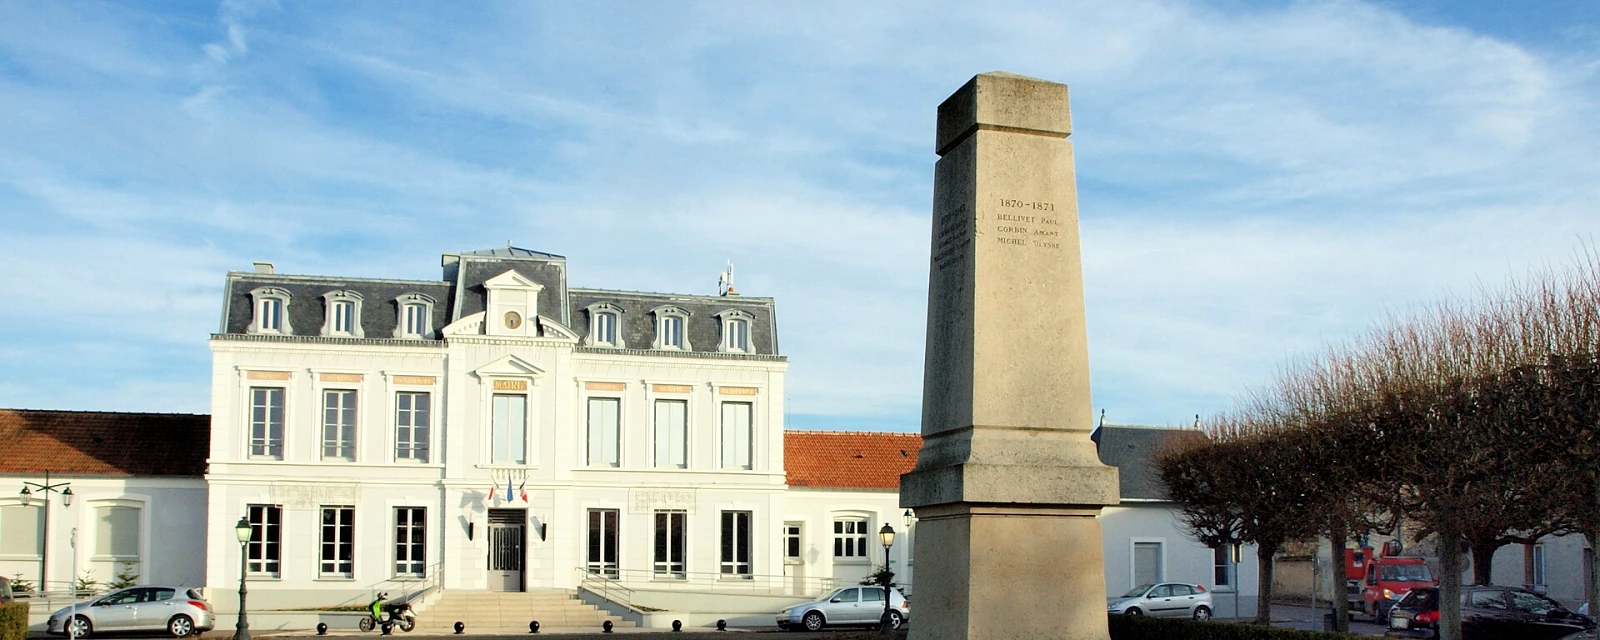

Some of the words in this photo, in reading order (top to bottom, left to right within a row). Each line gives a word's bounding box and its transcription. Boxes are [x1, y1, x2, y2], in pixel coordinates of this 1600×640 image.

[1000, 199, 1054, 211] 1870-1871
[997, 226, 1027, 234] CORBIN
[997, 238, 1027, 246] MICHEL
